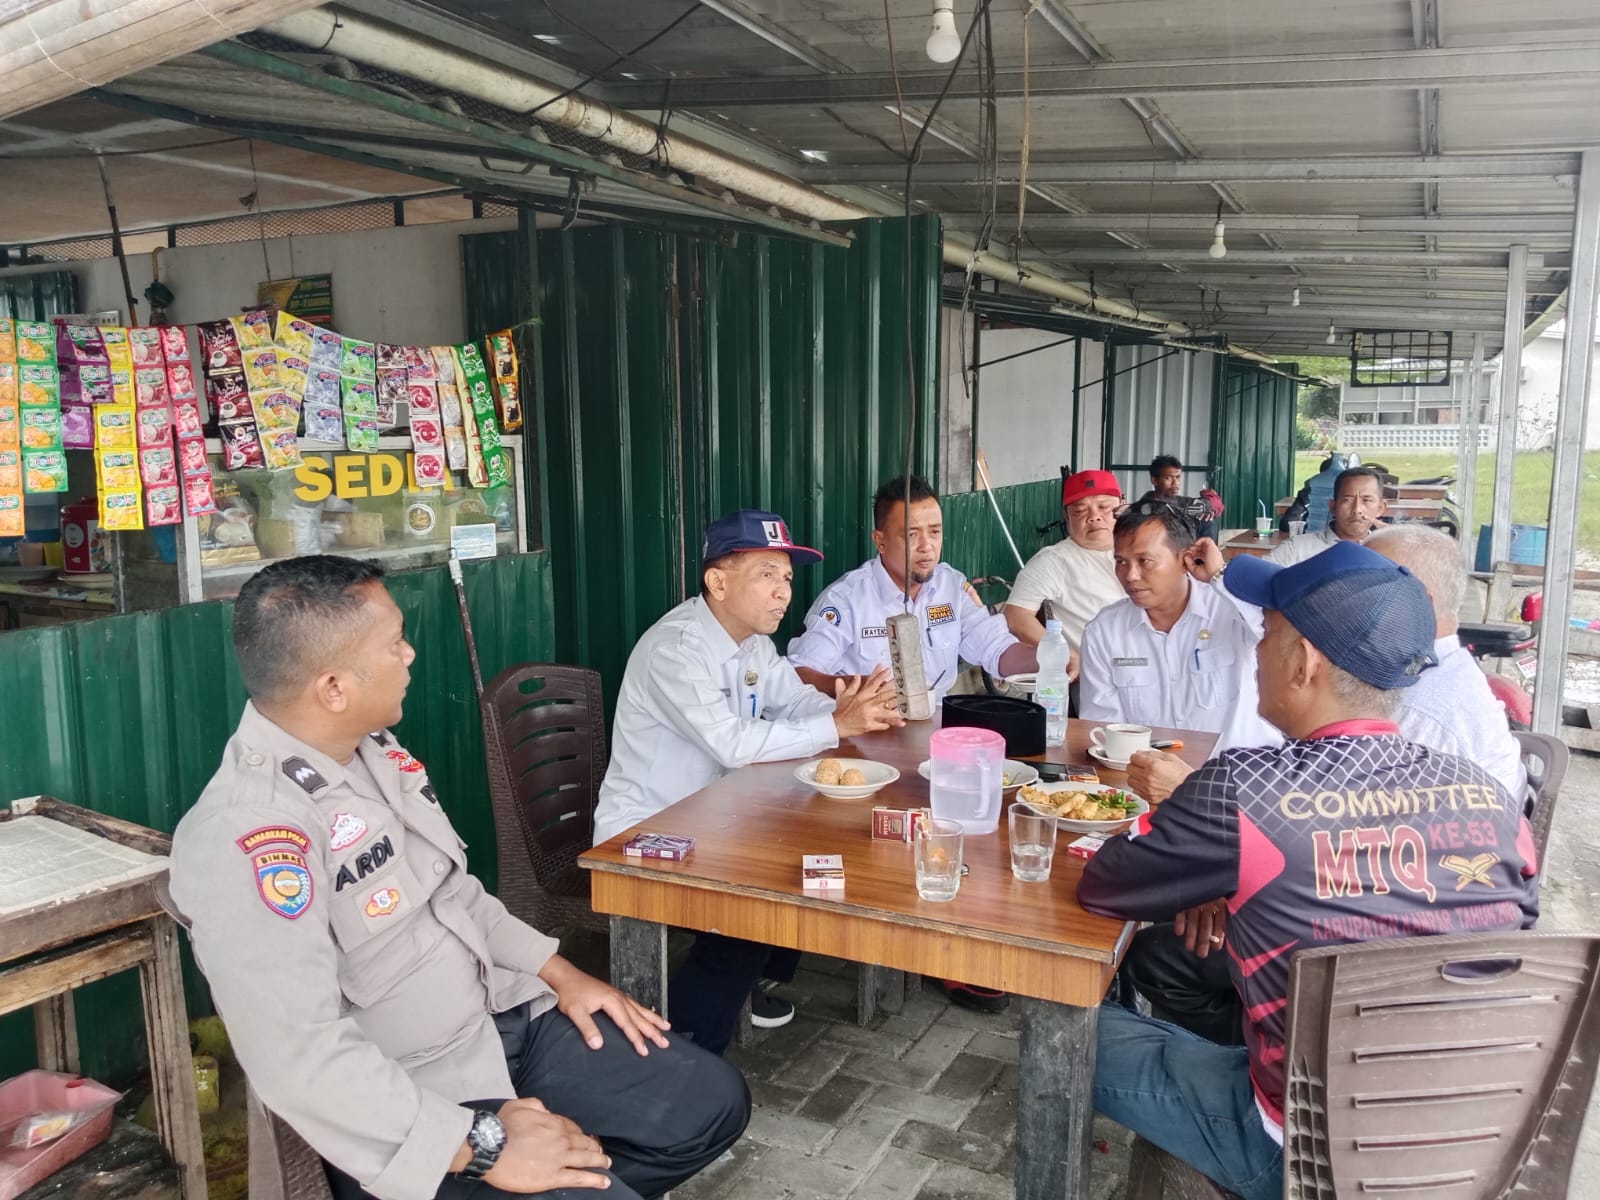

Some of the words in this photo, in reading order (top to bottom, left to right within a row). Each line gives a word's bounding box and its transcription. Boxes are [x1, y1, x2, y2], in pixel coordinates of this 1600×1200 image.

[1280, 783, 1504, 820] COMMITTEE
[335, 835, 395, 892] ARDI
[1312, 824, 1437, 903] MTQ
[1427, 821, 1498, 850] KE-53
